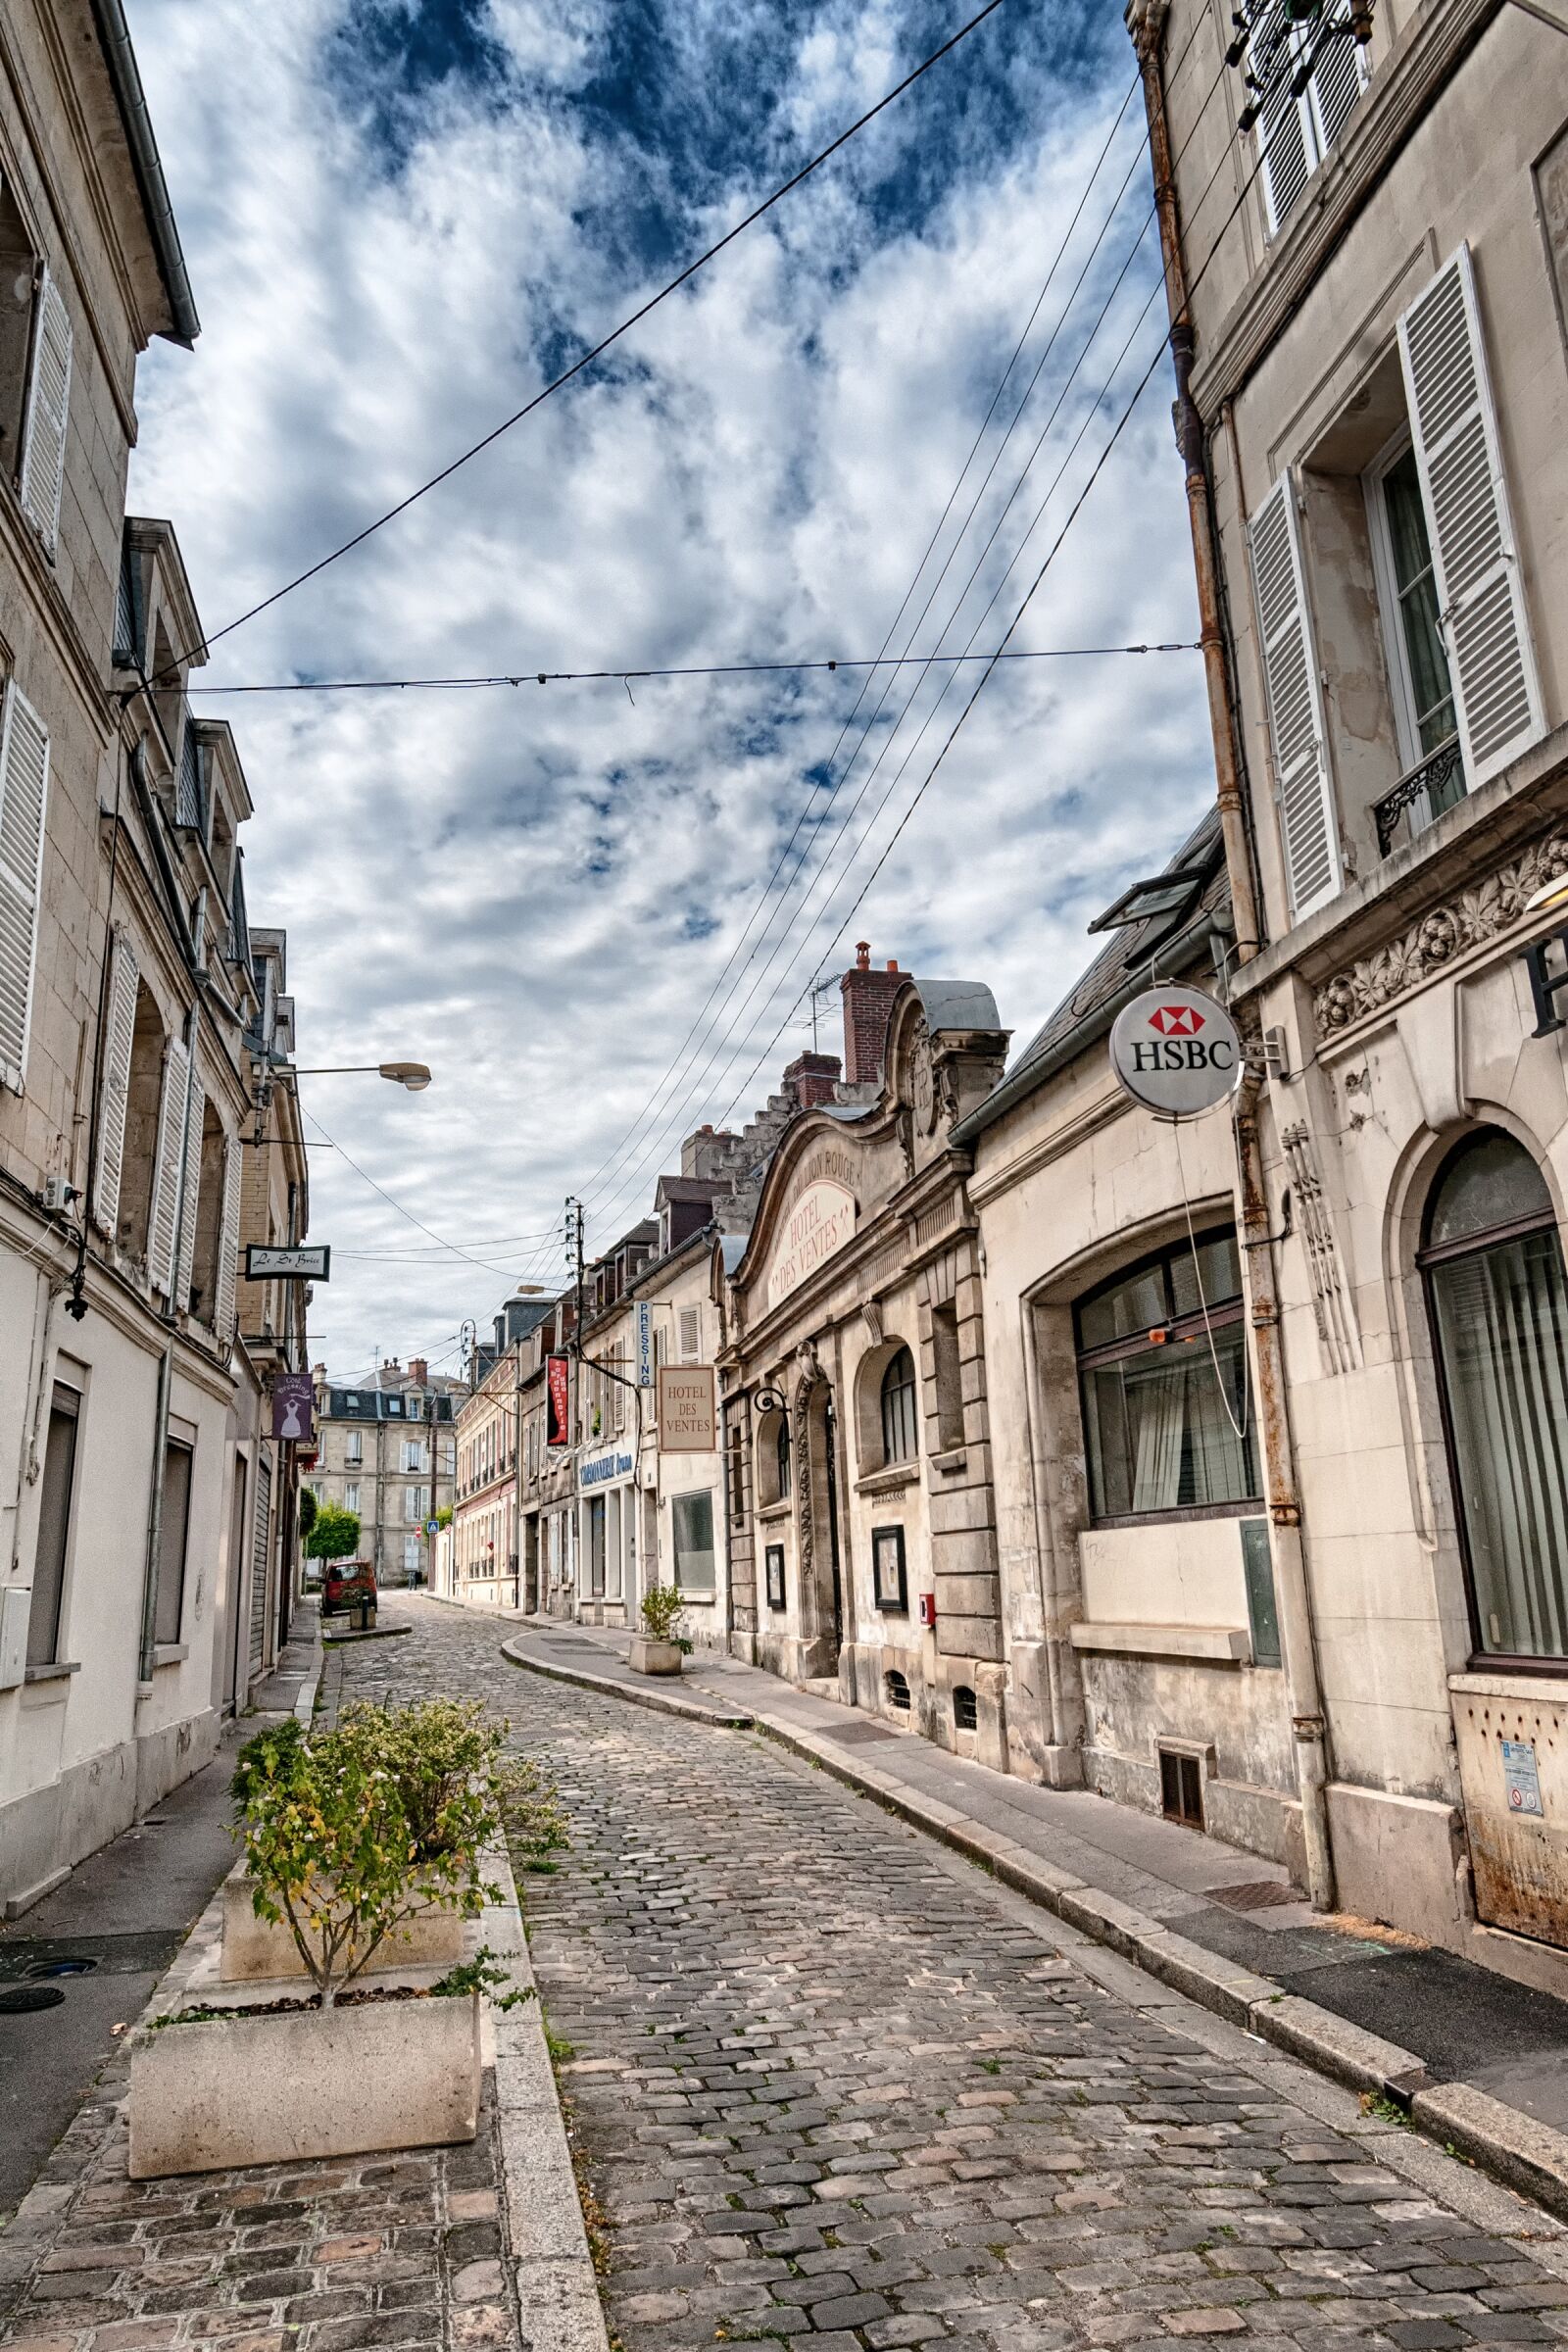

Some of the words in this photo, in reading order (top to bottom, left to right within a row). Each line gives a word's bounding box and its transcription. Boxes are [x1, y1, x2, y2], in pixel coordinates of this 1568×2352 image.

[1130, 1040, 1234, 1072] HSBC
[825, 1151, 856, 1187] ROUGE
[790, 1195, 822, 1250] HOTEL
[252, 1252, 270, 1267] Le
[295, 1253, 320, 1268] Brice
[779, 1255, 796, 1295] DES
[799, 1214, 839, 1272] VENTES
[640, 1302, 651, 1386] PRESSING
[554, 1360, 566, 1431] cordonnerie
[667, 1386, 707, 1399] HOTEL
[679, 1402, 697, 1416] DES
[666, 1420, 710, 1433] VENTES
